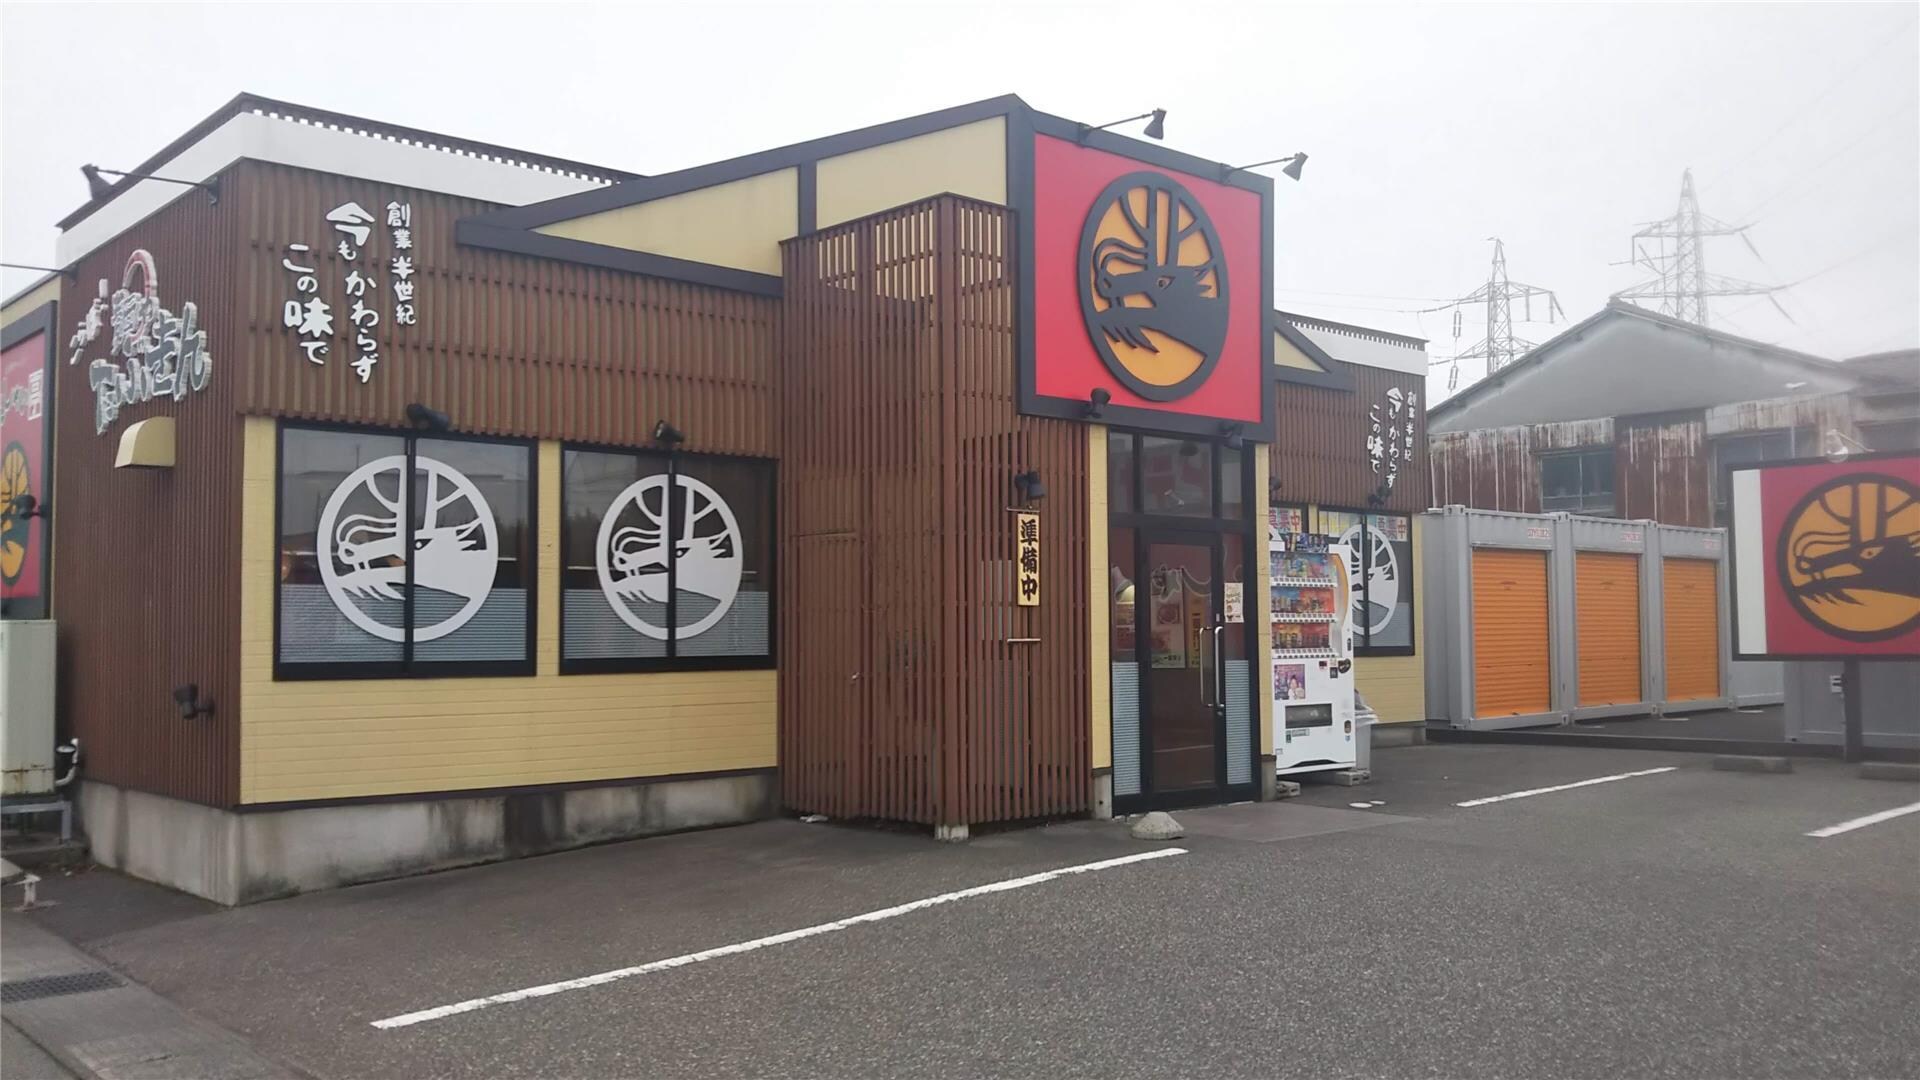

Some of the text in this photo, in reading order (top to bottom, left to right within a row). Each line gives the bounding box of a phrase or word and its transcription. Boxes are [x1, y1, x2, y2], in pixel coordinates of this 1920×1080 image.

[283, 243, 334, 364] この味で
[326, 202, 379, 383] 今もかわらず
[387, 201, 416, 325] 創業半世紀
[1366, 404, 1384, 473] この味で
[1020, 518, 1038, 602] 準備中
